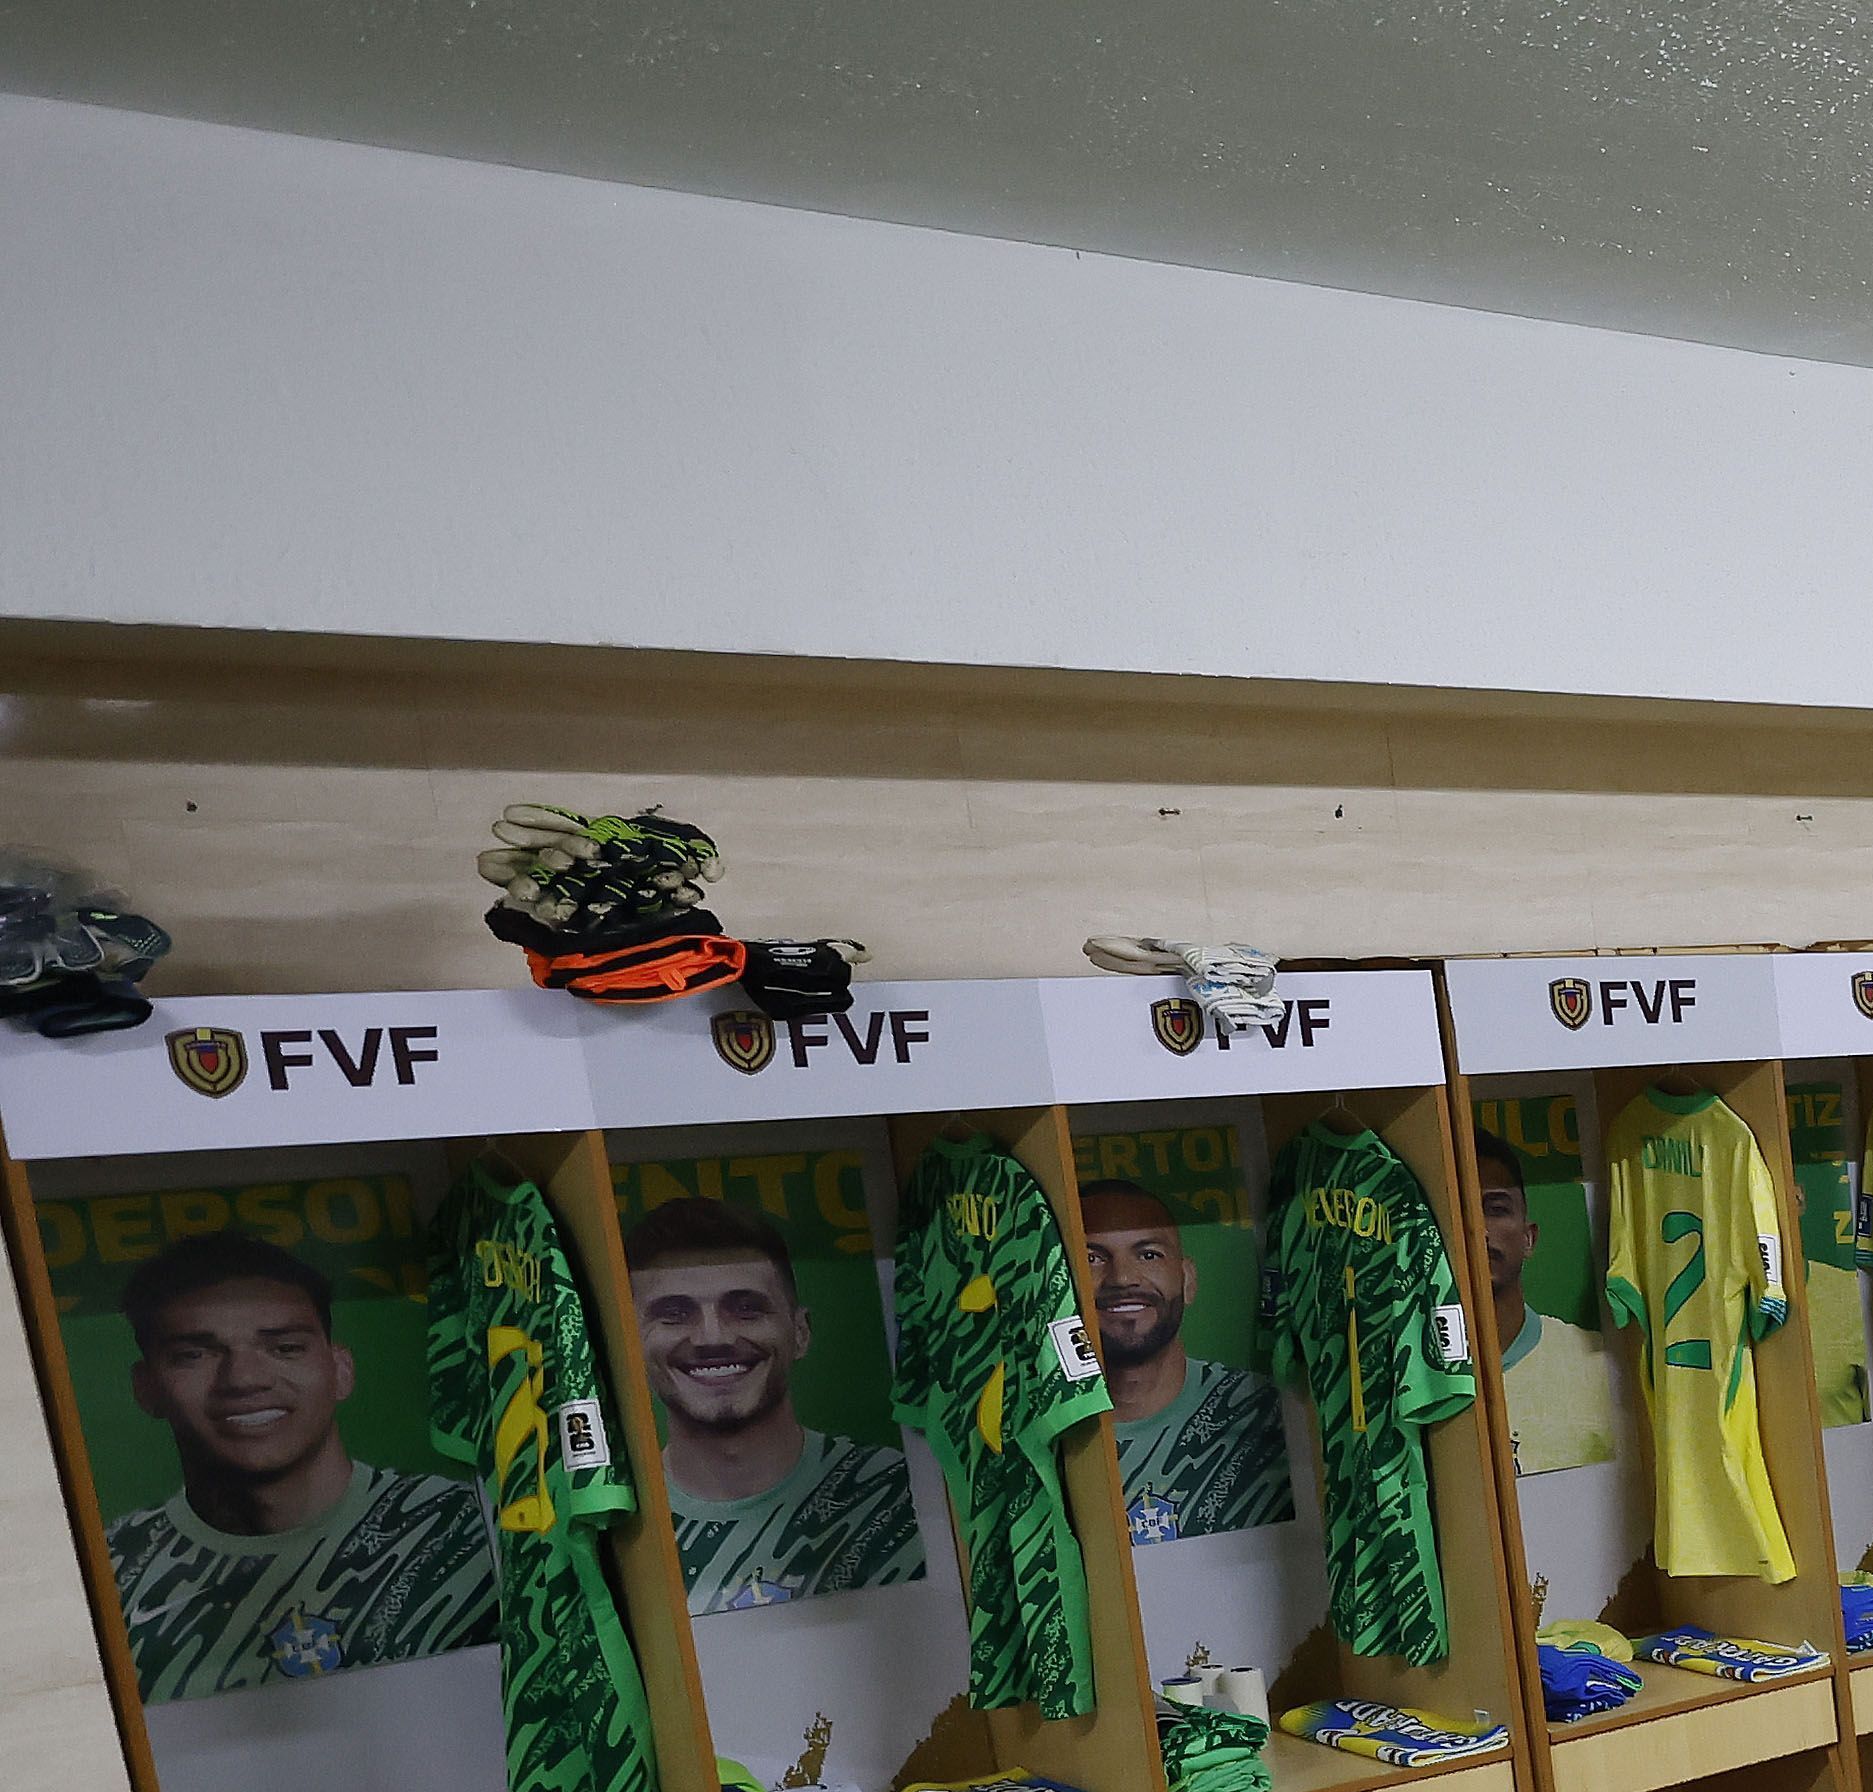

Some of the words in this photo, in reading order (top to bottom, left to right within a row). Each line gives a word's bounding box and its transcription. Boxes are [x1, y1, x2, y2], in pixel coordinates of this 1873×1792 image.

[1599, 979, 1696, 1026] FVF
[260, 1025, 439, 1091] FVF
[788, 1011, 930, 1067] FVF
[1661, 1211, 1711, 1370] 2
